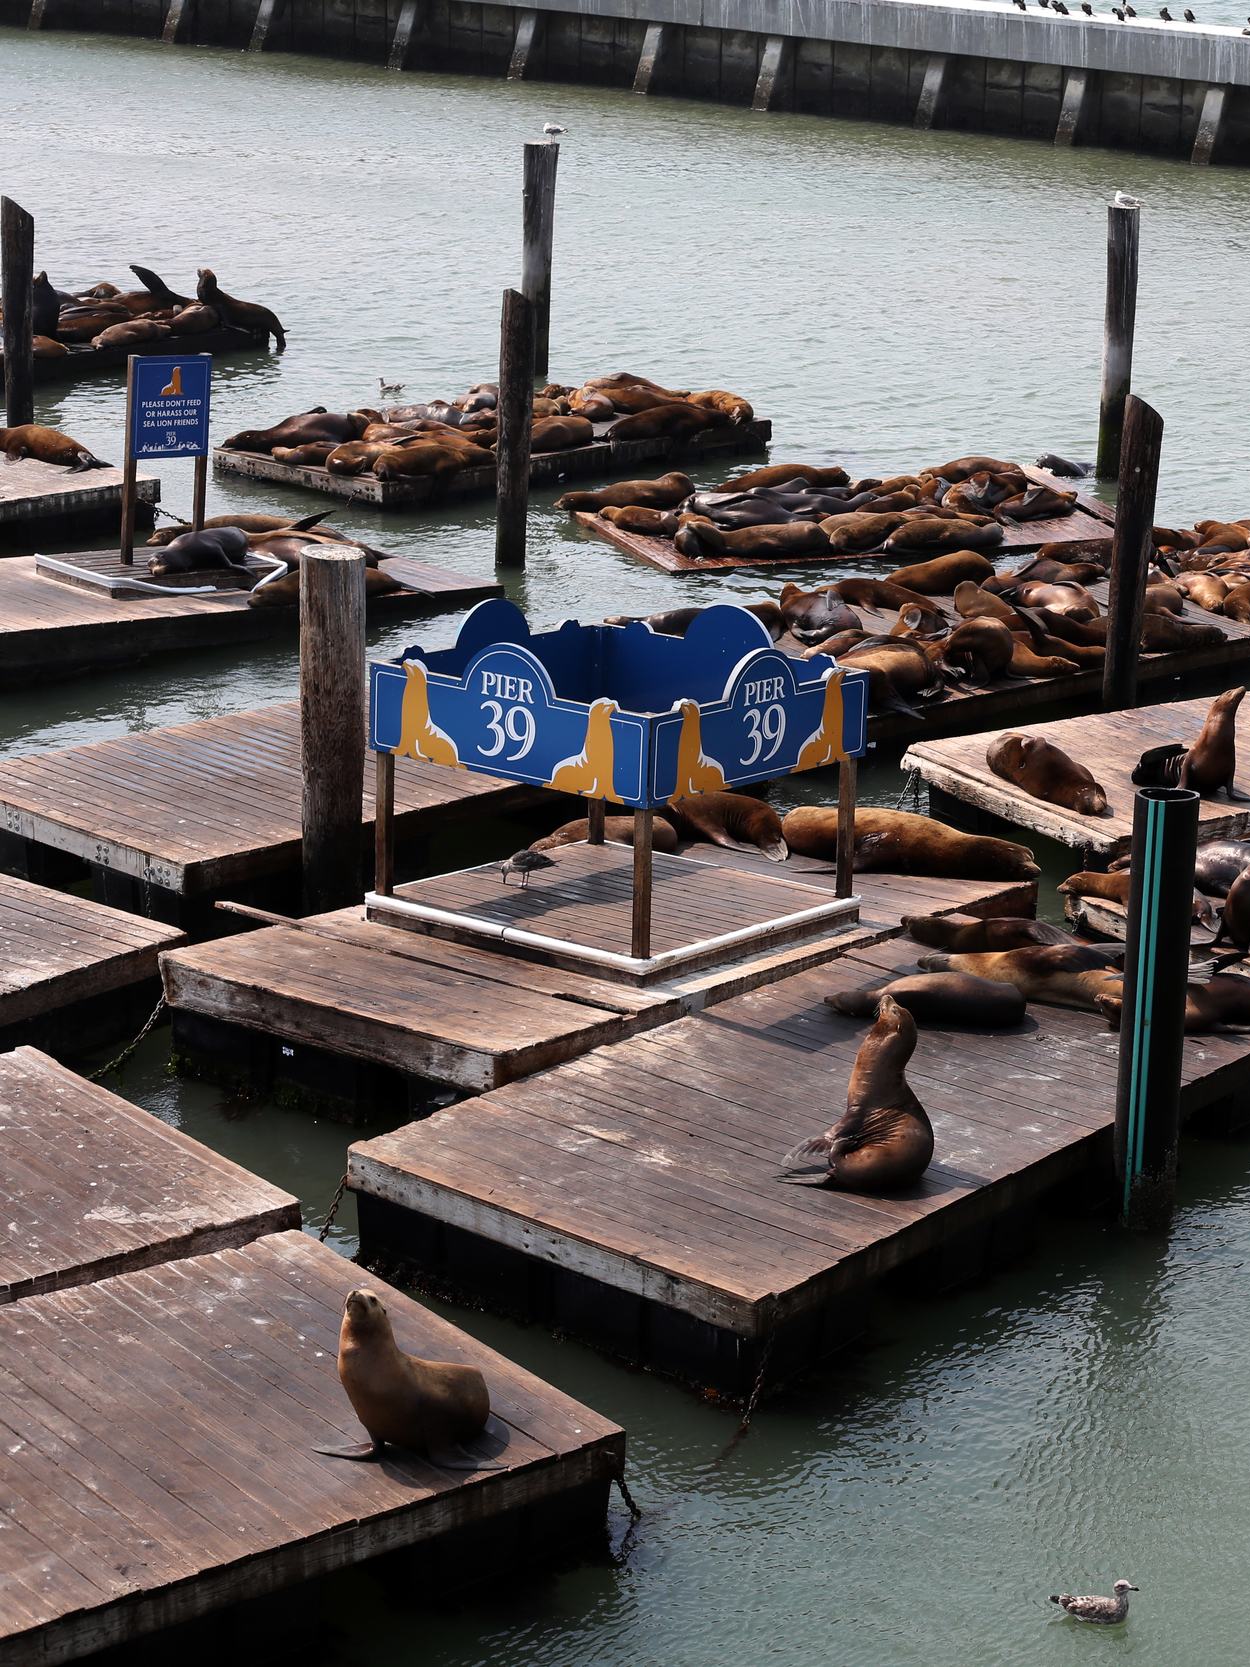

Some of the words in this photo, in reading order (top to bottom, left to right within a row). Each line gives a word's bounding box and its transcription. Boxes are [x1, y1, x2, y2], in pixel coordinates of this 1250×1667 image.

[157, 409, 182, 417] HARASS
[174, 418, 198, 426] FRIENDS
[165, 436, 176, 446] 39
[481, 670, 534, 704] PIER
[743, 676, 785, 706] PIER
[477, 700, 536, 761] 39
[740, 703, 786, 766] 39
